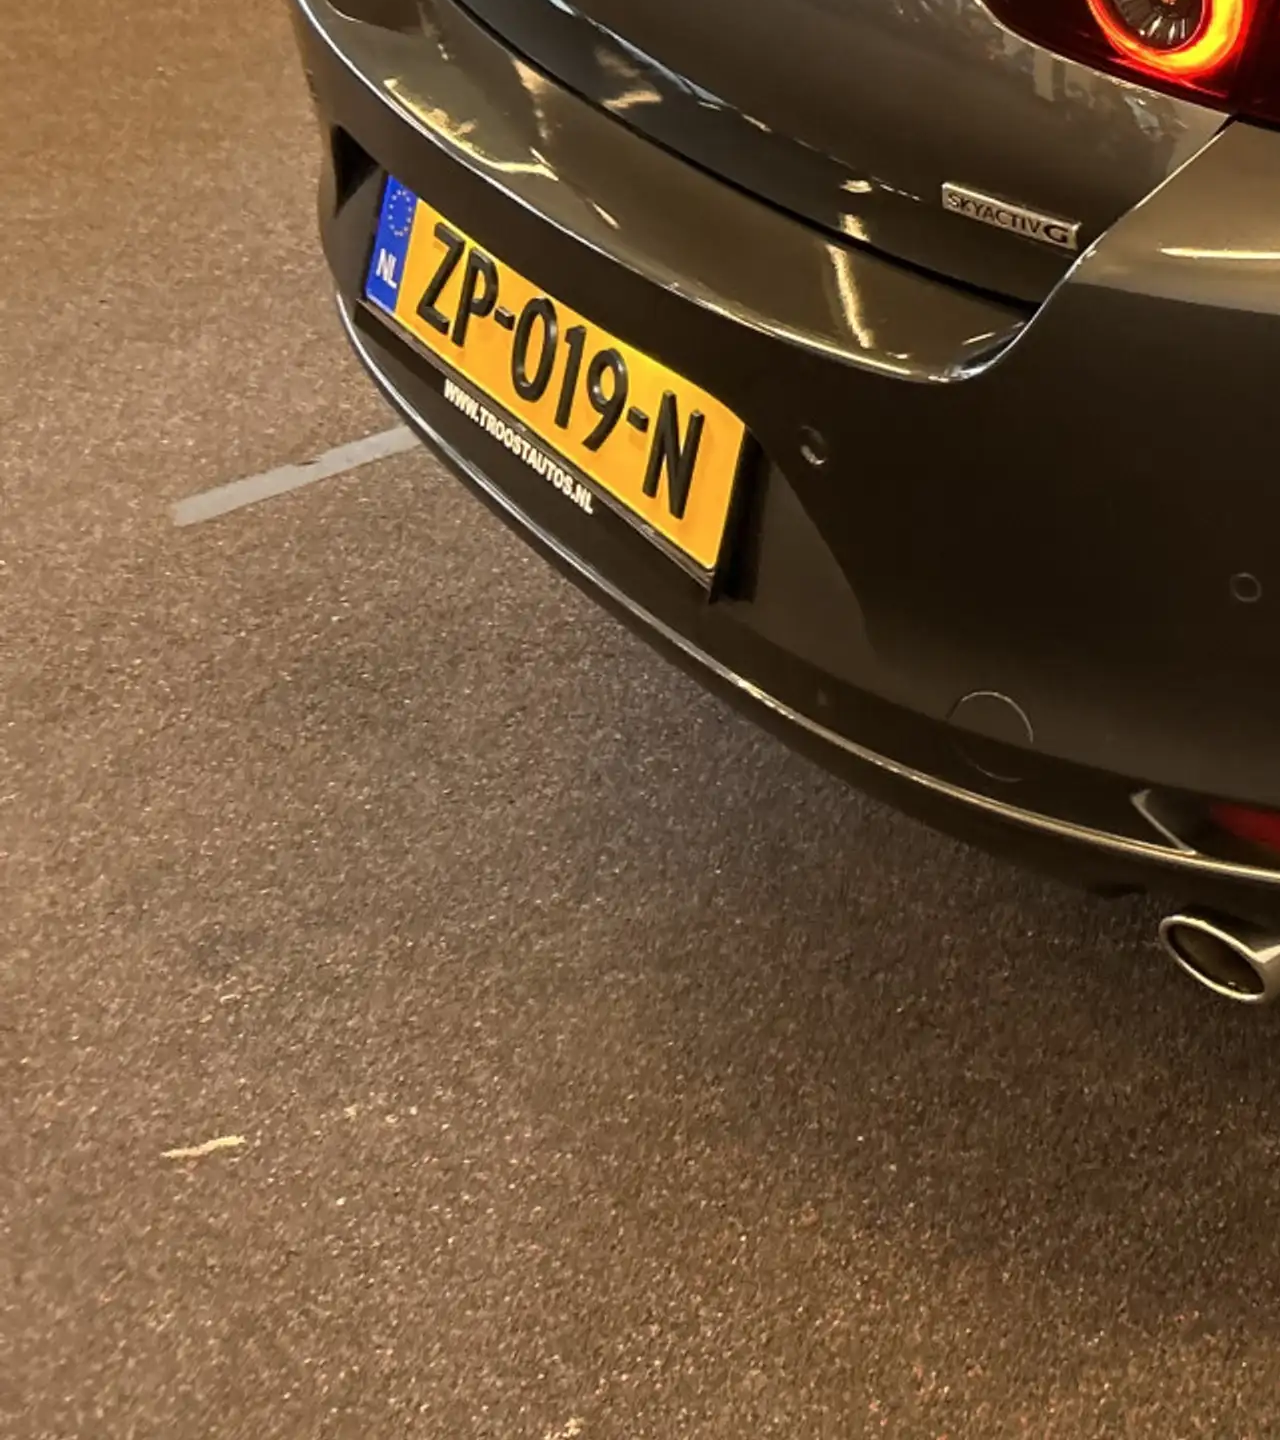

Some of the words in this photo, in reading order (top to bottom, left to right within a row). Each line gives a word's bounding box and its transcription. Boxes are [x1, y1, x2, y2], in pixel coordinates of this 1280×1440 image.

[947, 191, 1042, 235] SKYACTIV
[375, 246, 399, 290] NL
[416, 220, 706, 522] ZP-019-N
